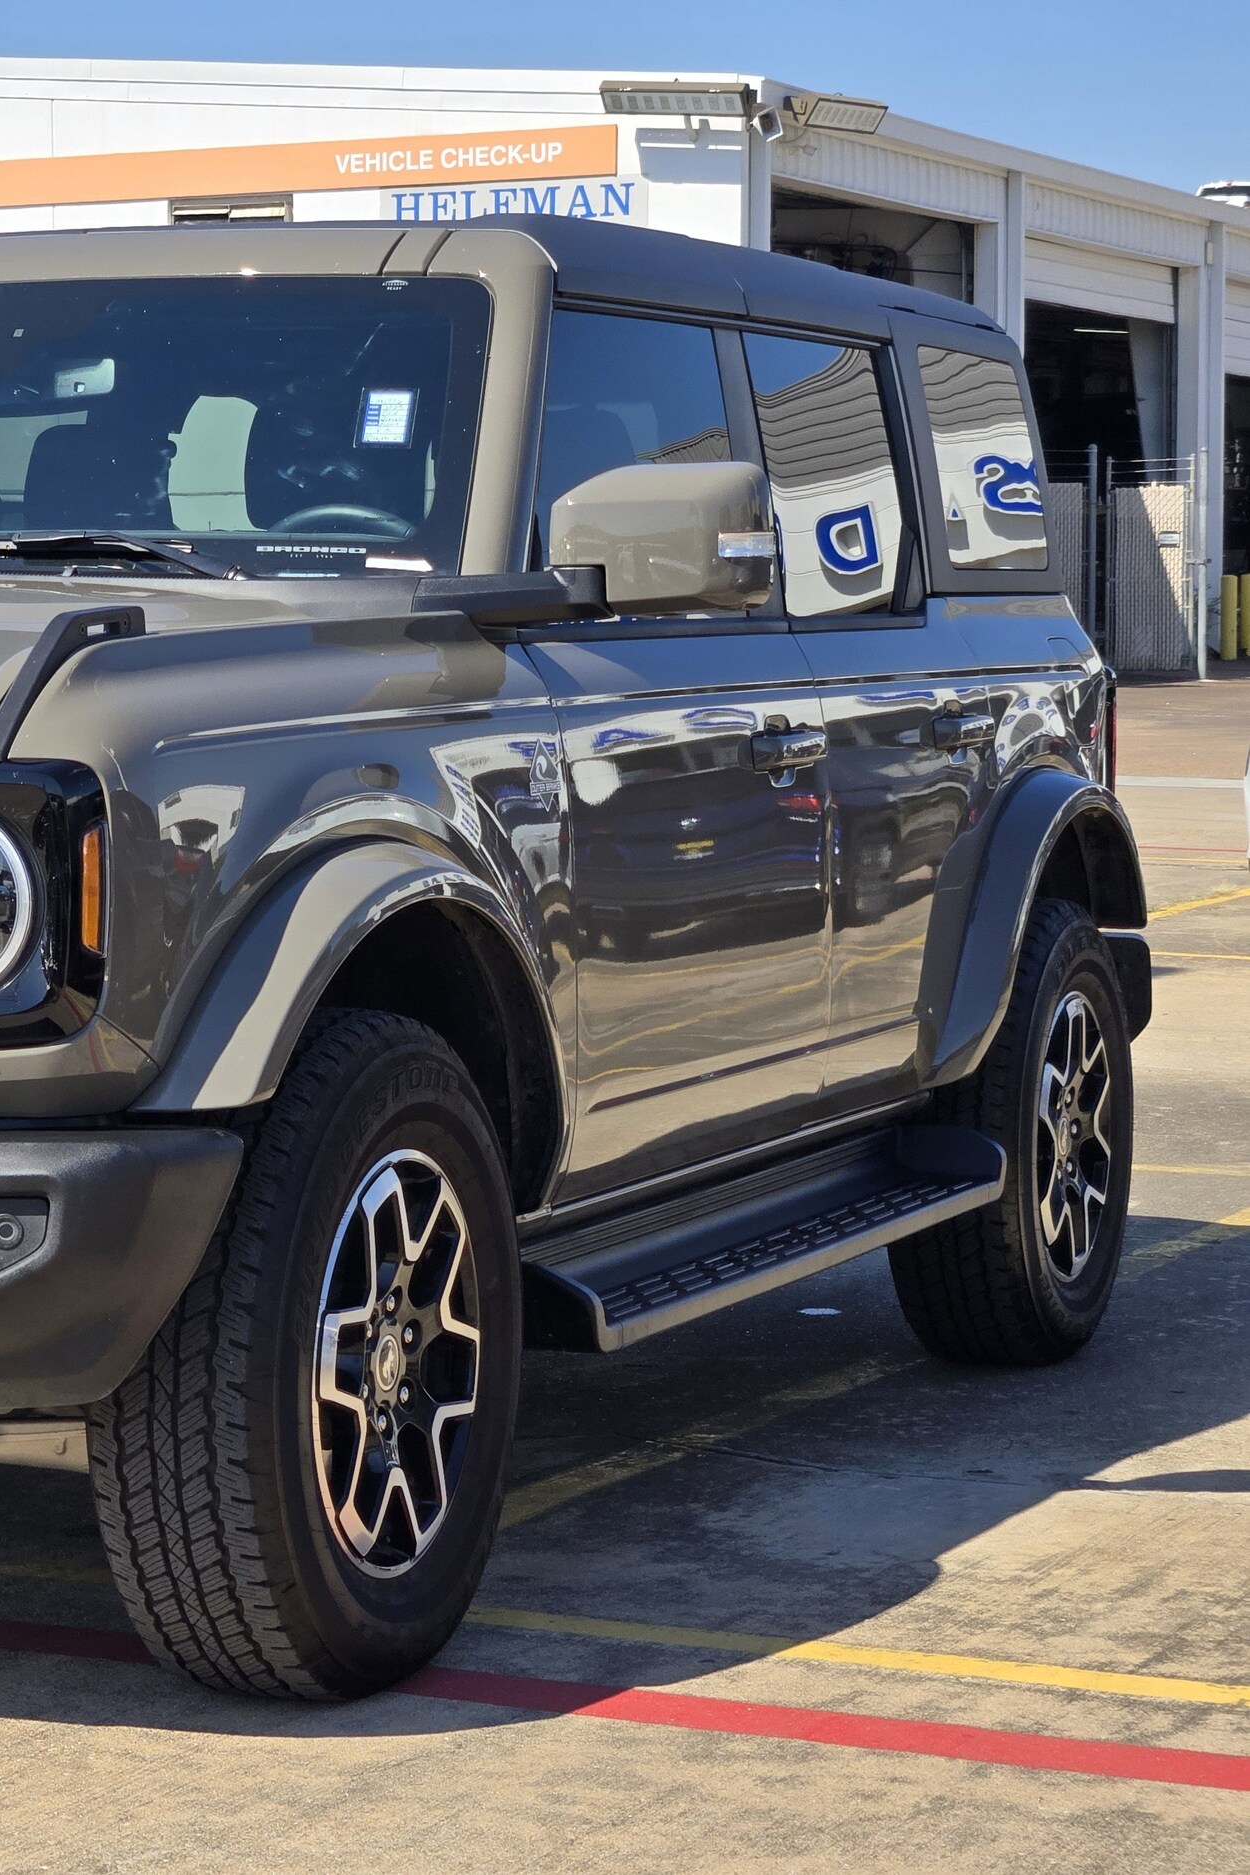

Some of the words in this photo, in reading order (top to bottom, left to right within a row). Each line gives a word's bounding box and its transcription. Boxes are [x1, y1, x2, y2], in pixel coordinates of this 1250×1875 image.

[335, 149, 434, 174] VEHICLE
[441, 142, 562, 169] CHECK-UP
[391, 182, 635, 221] HELFMAN
